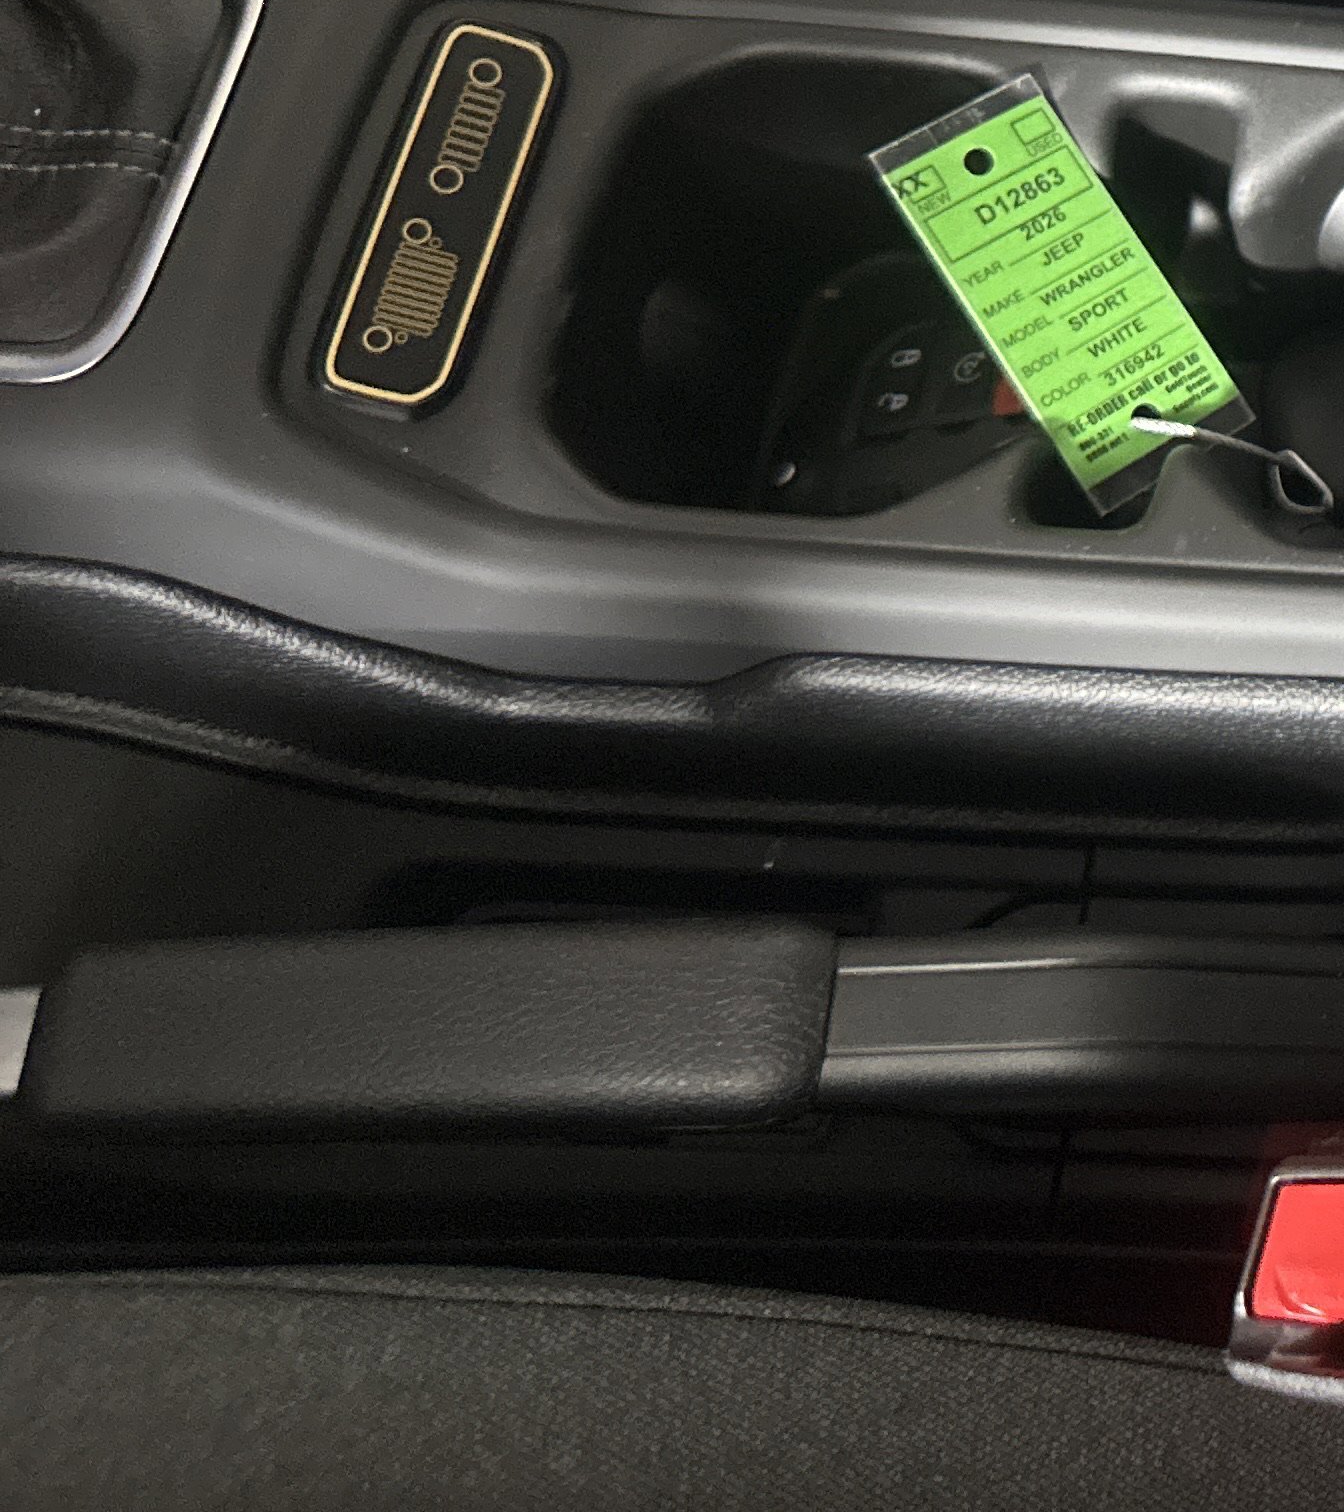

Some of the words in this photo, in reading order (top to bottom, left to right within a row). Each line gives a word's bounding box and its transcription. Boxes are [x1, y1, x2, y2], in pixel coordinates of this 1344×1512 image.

[1027, 129, 1064, 158] USED
[892, 170, 928, 201] XX
[916, 190, 952, 217] NEW
[974, 167, 1065, 225] D12863
[1019, 206, 1067, 241] 2026
[1041, 232, 1084, 266] JEEP
[962, 260, 1004, 287] YEAR
[1040, 248, 1134, 306] WRANGLER
[982, 289, 1024, 318] MAKE
[1068, 288, 1128, 332] SPORT
[1003, 312, 1054, 350] MODEL
[1087, 318, 1146, 358] WHITE
[1020, 346, 1064, 380] BODY
[1103, 343, 1165, 387] 316942
[1038, 370, 1092, 409] COLOR
[1070, 391, 1130, 438] RE-ORDER
[1126, 377, 1155, 401] call
[1152, 369, 1170, 386] or
[1167, 358, 1188, 378] go
[1183, 349, 1201, 367] to
